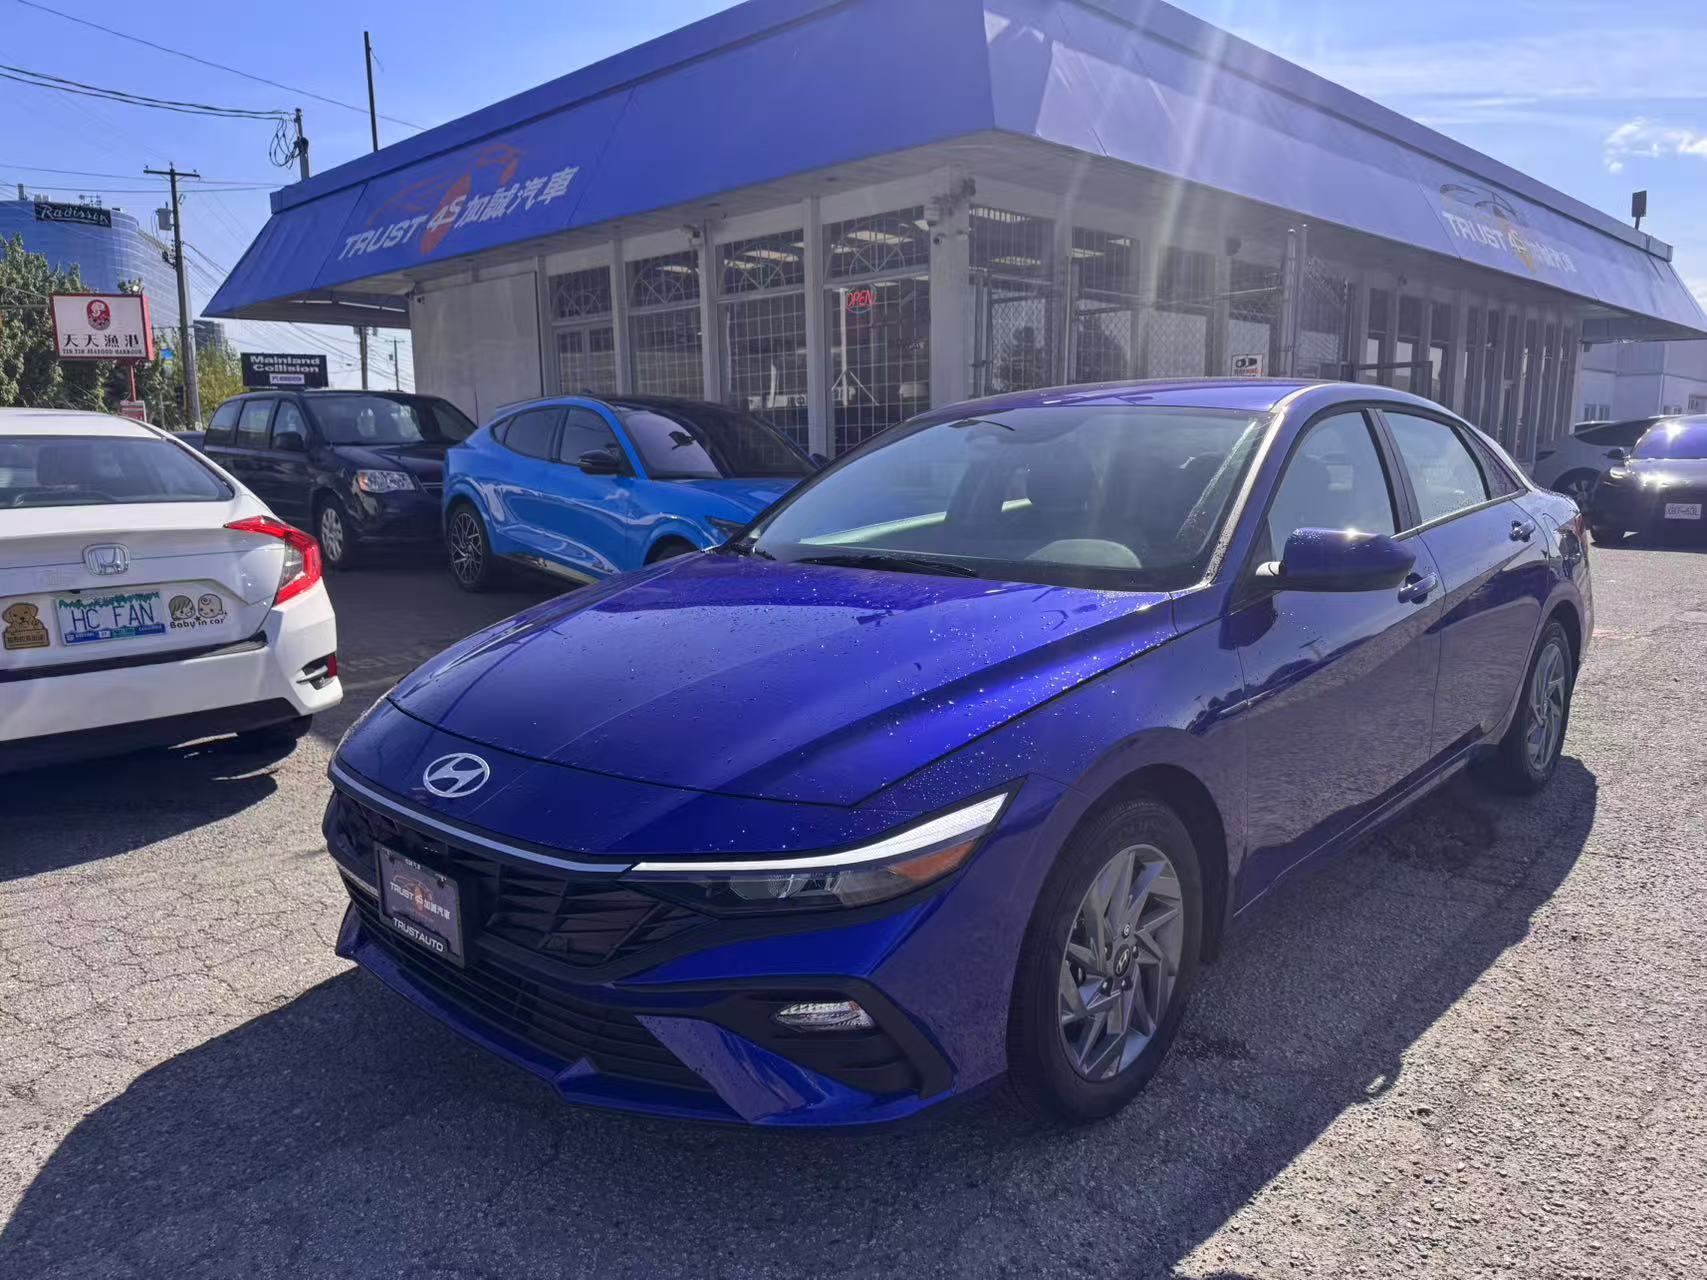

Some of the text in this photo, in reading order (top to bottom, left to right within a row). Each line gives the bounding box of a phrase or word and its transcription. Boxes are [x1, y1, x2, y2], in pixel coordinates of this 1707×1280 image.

[40, 204, 111, 225] Radisson
[337, 215, 428, 261] TRUST
[426, 195, 467, 232] 4S
[1441, 210, 1508, 253] TRUST
[847, 290, 874, 307] OPEN
[249, 355, 321, 365] Mainland
[252, 364, 320, 373] Collision
[71, 603, 155, 631] HC FAN
[169, 618, 225, 630] Baby in car
[389, 881, 415, 901] TRUST
[393, 917, 445, 953] TRUSTAUTO
